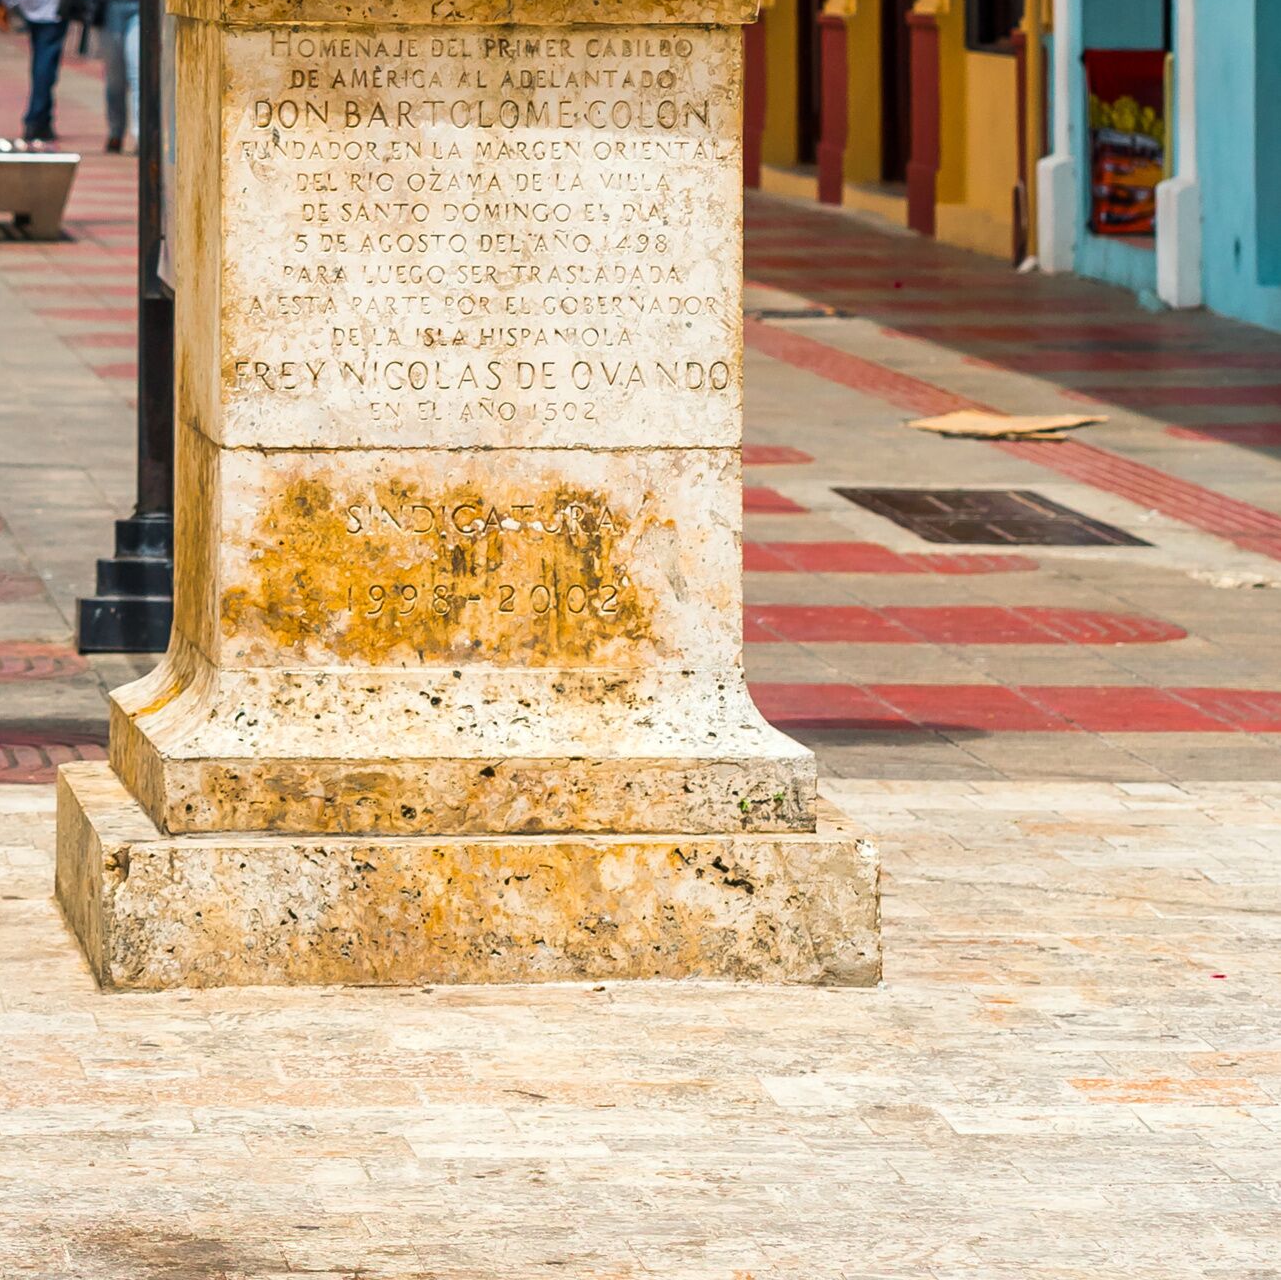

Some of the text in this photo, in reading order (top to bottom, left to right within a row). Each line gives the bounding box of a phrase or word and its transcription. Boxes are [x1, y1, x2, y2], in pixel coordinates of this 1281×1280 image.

[270, 30, 692, 58] HOMENAJE DEL PRIMER CABILDO
[291, 69, 318, 88] DE
[457, 70, 487, 88] AL
[501, 70, 675, 88] ADELANTADO
[254, 100, 710, 129] DON BARTOLOME COLON
[241, 141, 724, 160] FUNDADOR EN LA MARGEN ORIENTAL
[297, 173, 337, 191] DEL
[407, 173, 502, 192] OZAMA
[517, 173, 542, 191] DE
[556, 173, 584, 191] LA
[600, 173, 670, 191] VILLA
[302, 203, 329, 222] DE
[341, 203, 429, 222] SANTO
[444, 203, 571, 222] DOMINGO
[585, 203, 610, 222] EL
[295, 229, 668, 252] 5 DE AGOSTO DEL AÑO 1498
[284, 265, 682, 284] PARA LUEGO SER TRASLADADA
[249, 296, 718, 315] A ESTA PARTE POR EL GOBERNADOR
[333, 327, 359, 346] DE
[373, 327, 401, 346] LA
[416, 327, 464, 346] ISLA
[235, 361, 729, 390] FREY NICOLAS DE OVANDO
[371, 397, 596, 421] EN EL AÑO 1502
[346, 504, 619, 534] SINDICATURA
